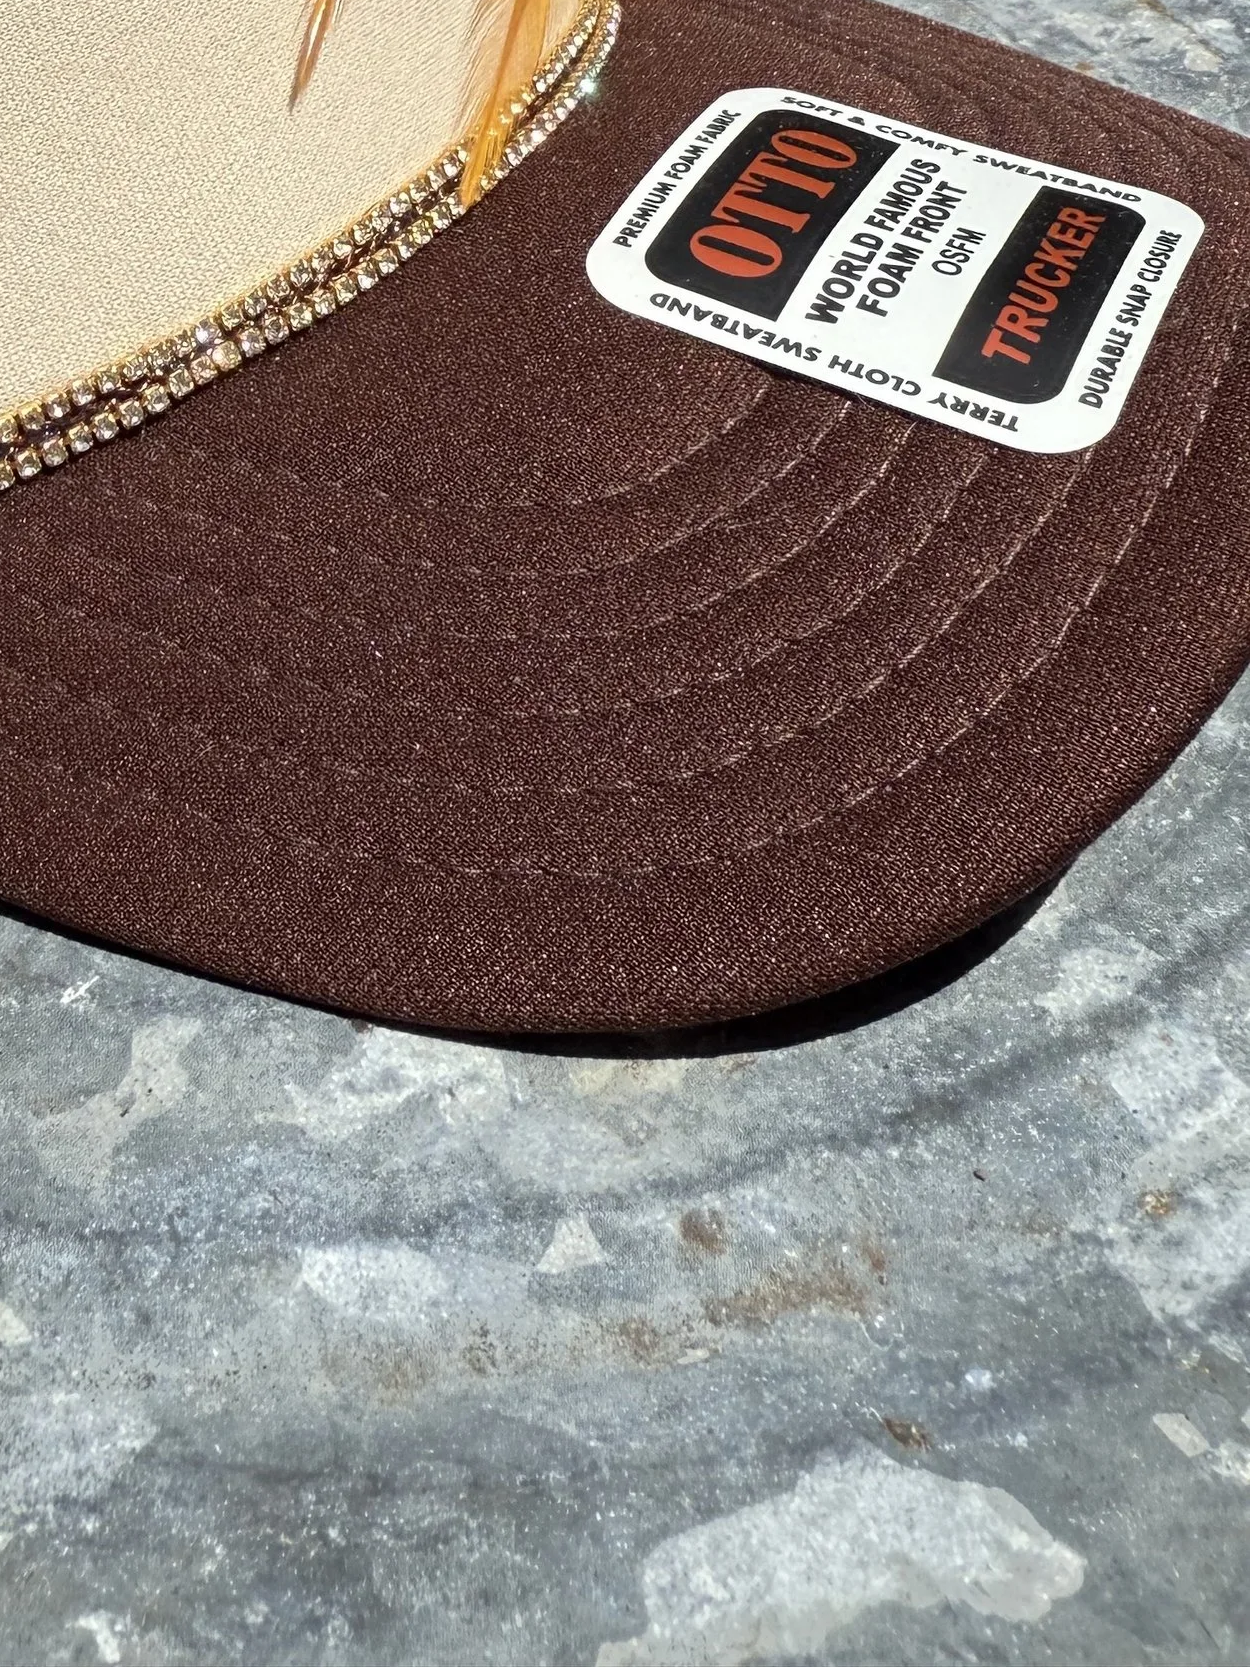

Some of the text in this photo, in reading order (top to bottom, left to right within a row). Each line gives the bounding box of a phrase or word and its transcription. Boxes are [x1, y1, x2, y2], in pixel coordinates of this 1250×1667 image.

[612, 109, 742, 248] PREMIUM FOAM FABRIC
[690, 129, 857, 278] OTTO
[781, 96, 1142, 203] SOFT & COMFY SWEATBAND
[805, 158, 941, 325] WORLD FAMOUS
[856, 181, 967, 318] FOAM FRONT
[931, 227, 986, 276] OSFM
[981, 206, 1106, 365] TRUCKER
[650, 292, 1019, 433] TERRY CLOTH SWEATBAND
[1078, 229, 1182, 409] DURABLE SNAP CLOSURE
